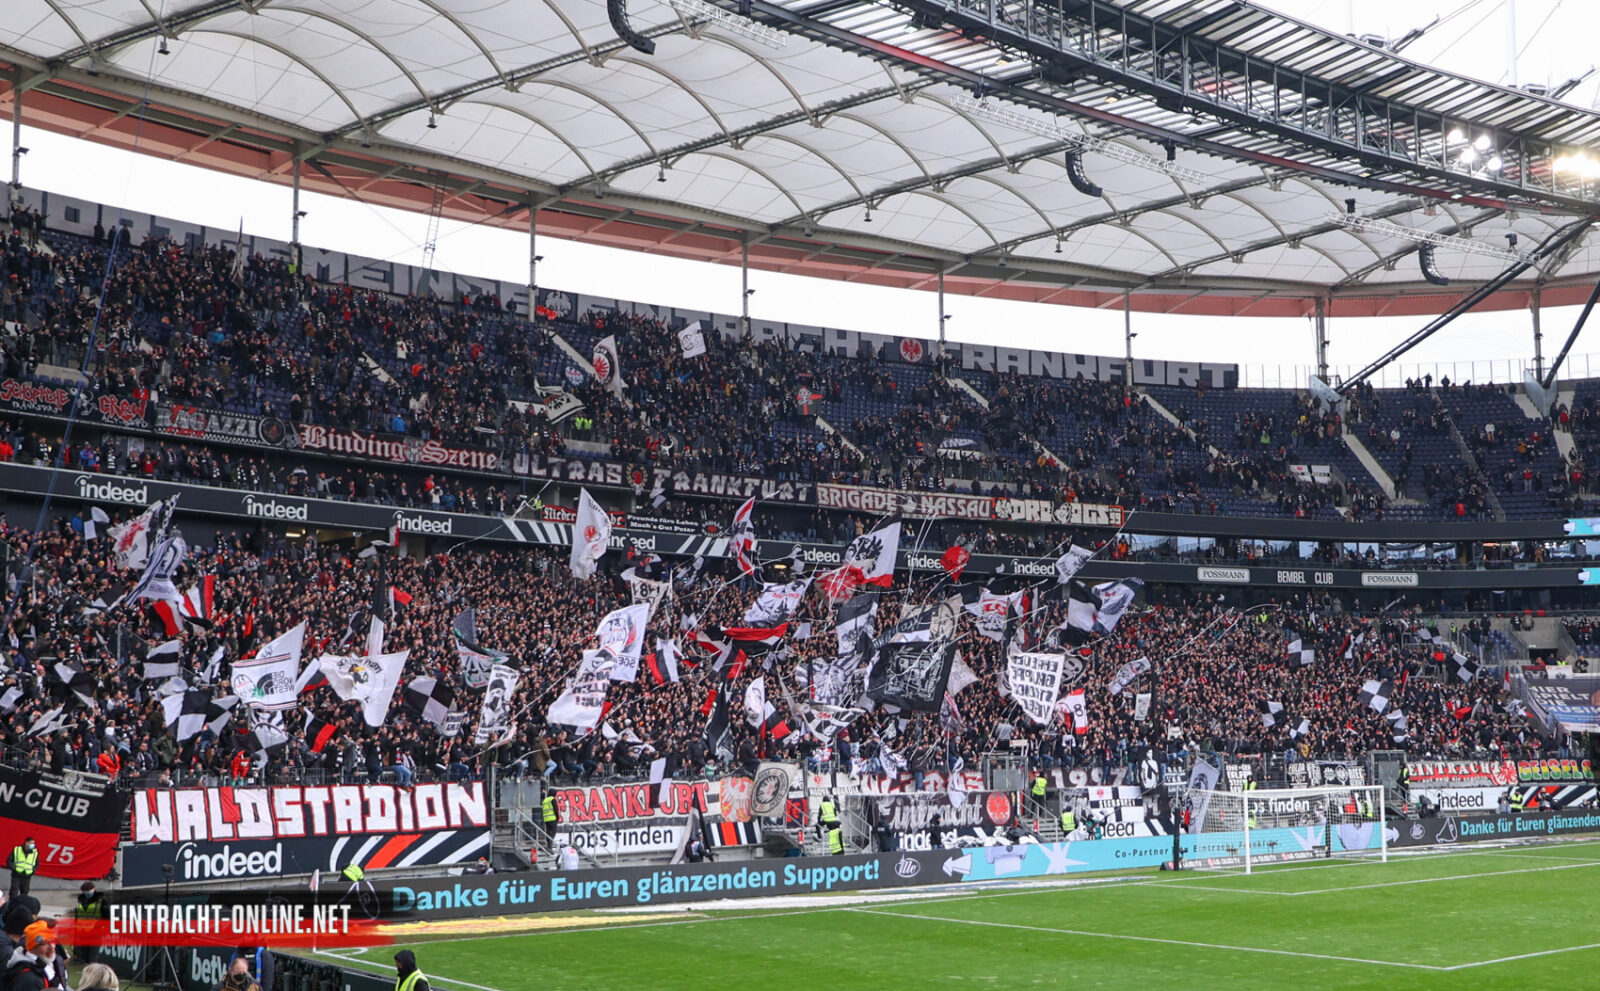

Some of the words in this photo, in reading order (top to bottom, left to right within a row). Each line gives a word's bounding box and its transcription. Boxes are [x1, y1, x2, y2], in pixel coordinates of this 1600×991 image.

[929, 339, 1233, 389] FRANKFURT
[100, 395, 147, 421] CREW
[155, 407, 257, 438] RAGAZZI
[299, 423, 407, 463] Binding
[420, 440, 498, 471] Szene
[513, 453, 623, 484] ULTRAS
[653, 467, 814, 502] FRANKFURT
[80, 479, 148, 504] indeed
[816, 487, 897, 511] BRIGADE
[920, 496, 992, 518] NASSAU
[246, 501, 308, 521] indeed
[397, 511, 452, 534] indeed
[1014, 561, 1055, 575] indeed
[1203, 570, 1245, 579] POSSMANN
[1277, 571, 1306, 584] BEMBEL
[1315, 572, 1334, 585] CLUB
[1367, 574, 1413, 583] POSSMANN
[556, 781, 709, 823] FRANKURT
[1438, 791, 1484, 809] indeed
[134, 782, 487, 843] WALDSTADION
[614, 826, 673, 847] finden
[1461, 820, 1495, 836] Danke
[1498, 817, 1513, 832] für
[1516, 817, 1545, 831] Euren
[46, 843, 75, 865] 75
[184, 842, 282, 879] indeed
[1115, 848, 1169, 858] Co-Partner
[392, 879, 488, 911] Danke
[498, 879, 541, 904] für
[551, 877, 628, 901] Euren
[637, 867, 776, 903] glänzenden
[784, 860, 880, 890] Support!
